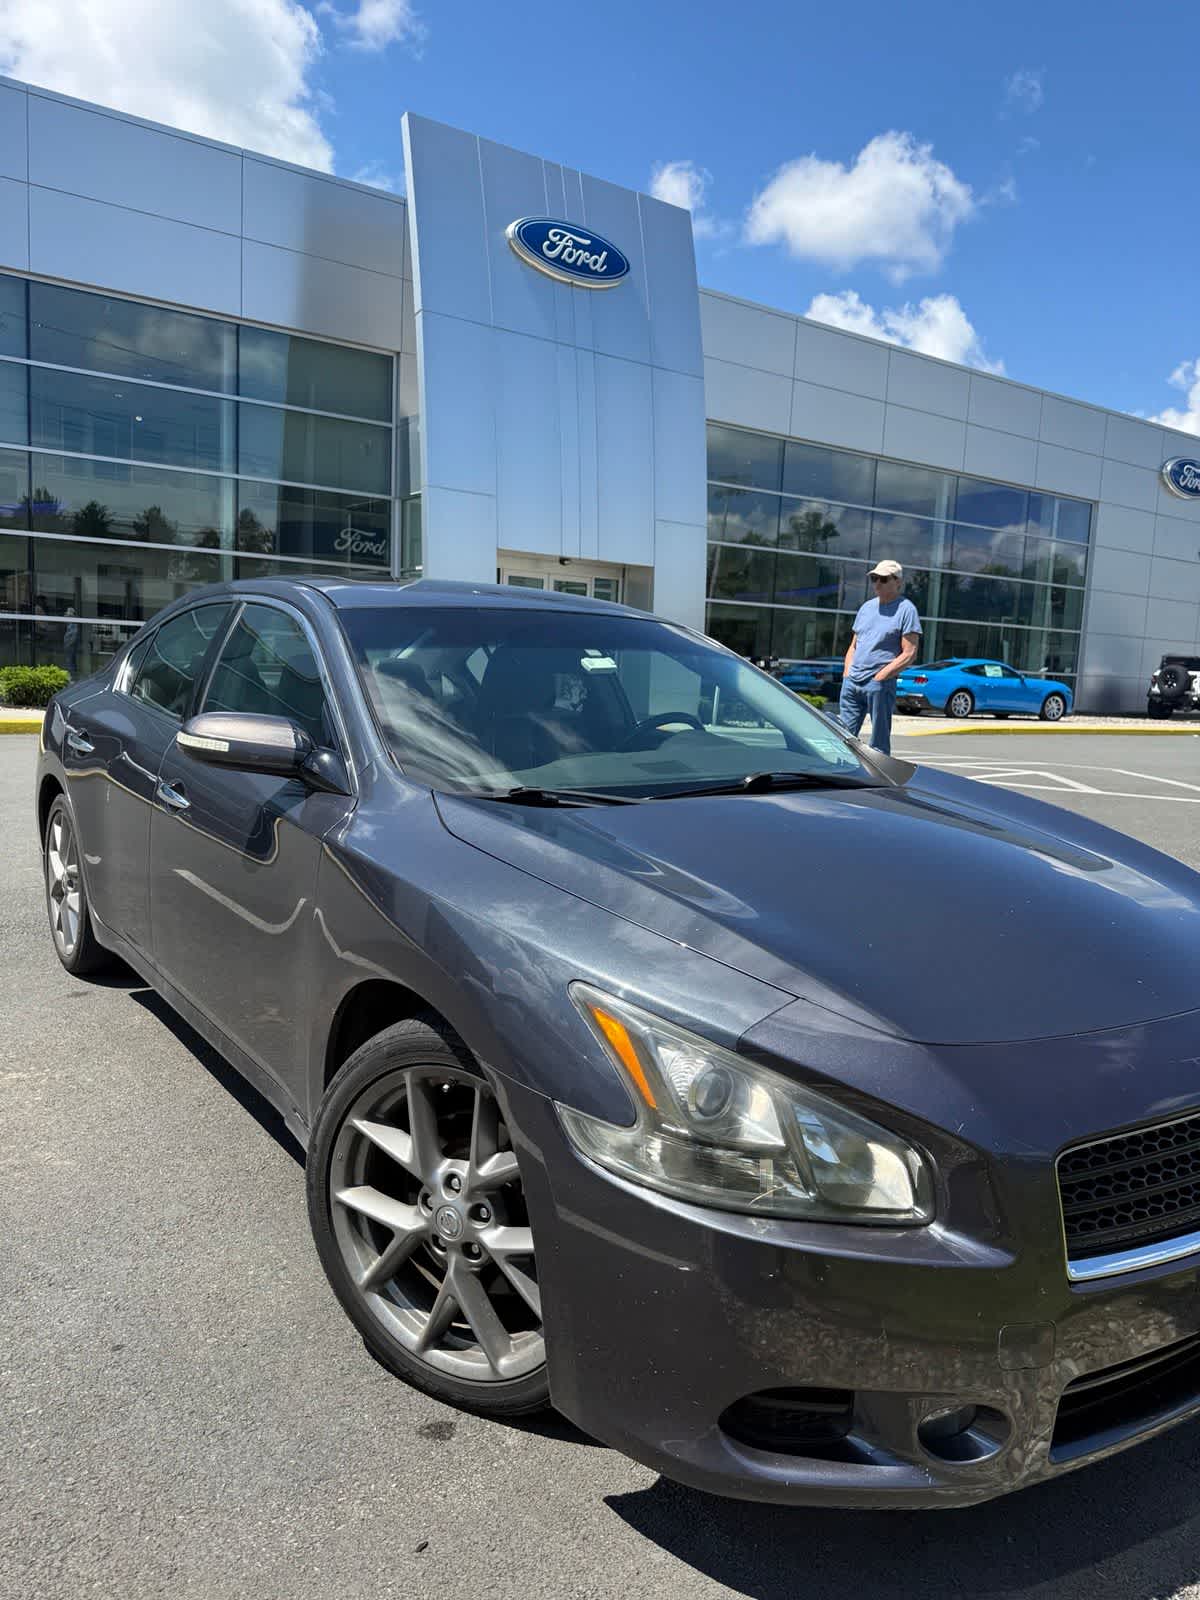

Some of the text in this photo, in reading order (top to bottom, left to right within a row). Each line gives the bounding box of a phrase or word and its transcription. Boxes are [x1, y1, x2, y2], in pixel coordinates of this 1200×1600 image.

[542, 228, 608, 272] Ford
[1179, 464, 1200, 490] For
[334, 527, 386, 556] Ford
